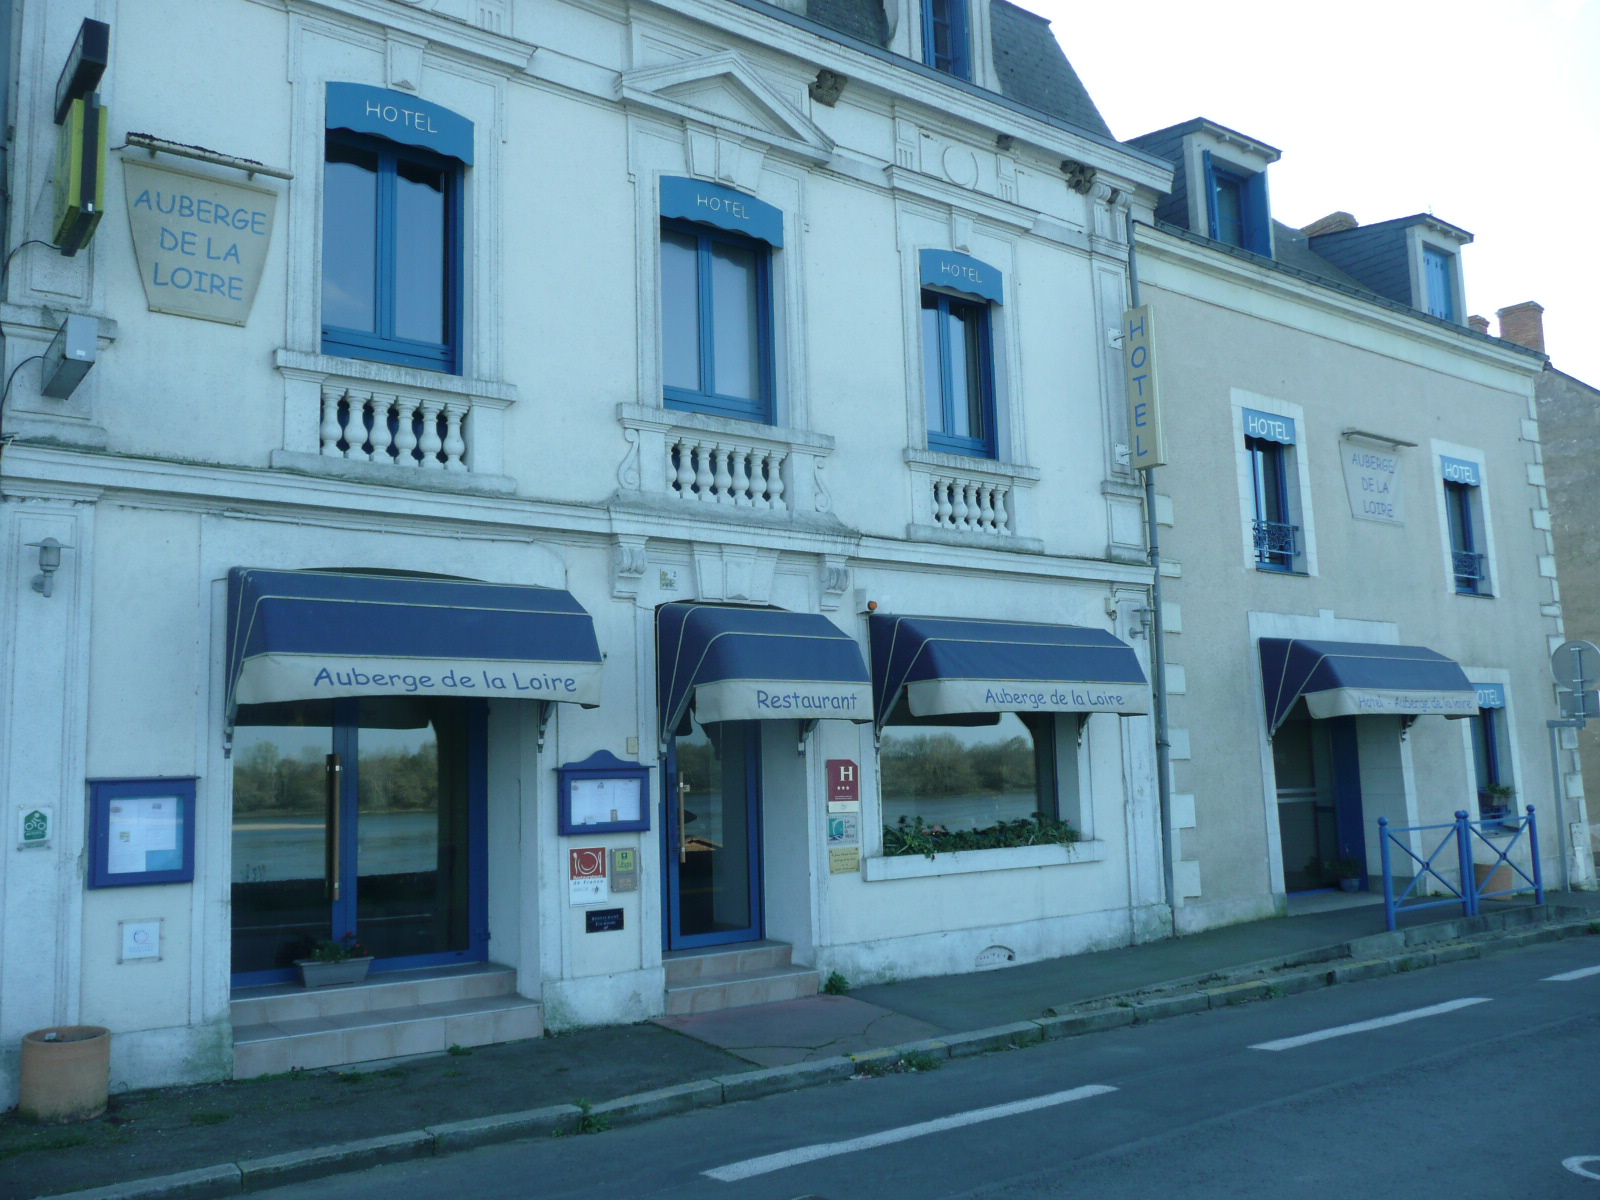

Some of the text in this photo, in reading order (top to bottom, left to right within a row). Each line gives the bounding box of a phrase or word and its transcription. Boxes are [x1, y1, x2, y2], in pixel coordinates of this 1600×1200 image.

[366, 99, 438, 133] HOTEL
[134, 189, 267, 235] AUBERGE
[697, 193, 751, 219] HOTEL
[160, 226, 240, 265] DE LA
[153, 262, 244, 301] LOIRE
[941, 260, 982, 283] HOTEL
[1129, 315, 1148, 457] HOTEL
[1248, 415, 1290, 440] HOTEL
[1351, 453, 1394, 474] AUBERGE
[1444, 462, 1476, 483] HOTEL
[1362, 477, 1389, 494] DE LA
[1363, 499, 1394, 518] LOIRE
[313, 667, 577, 692] Auberge de la Loire
[756, 690, 857, 709] Restaurant
[985, 688, 1125, 708] Auberge de la Loire
[1394, 695, 1430, 712] Auberge
[1477, 689, 1501, 704] OTEL
[839, 766, 854, 782] H
